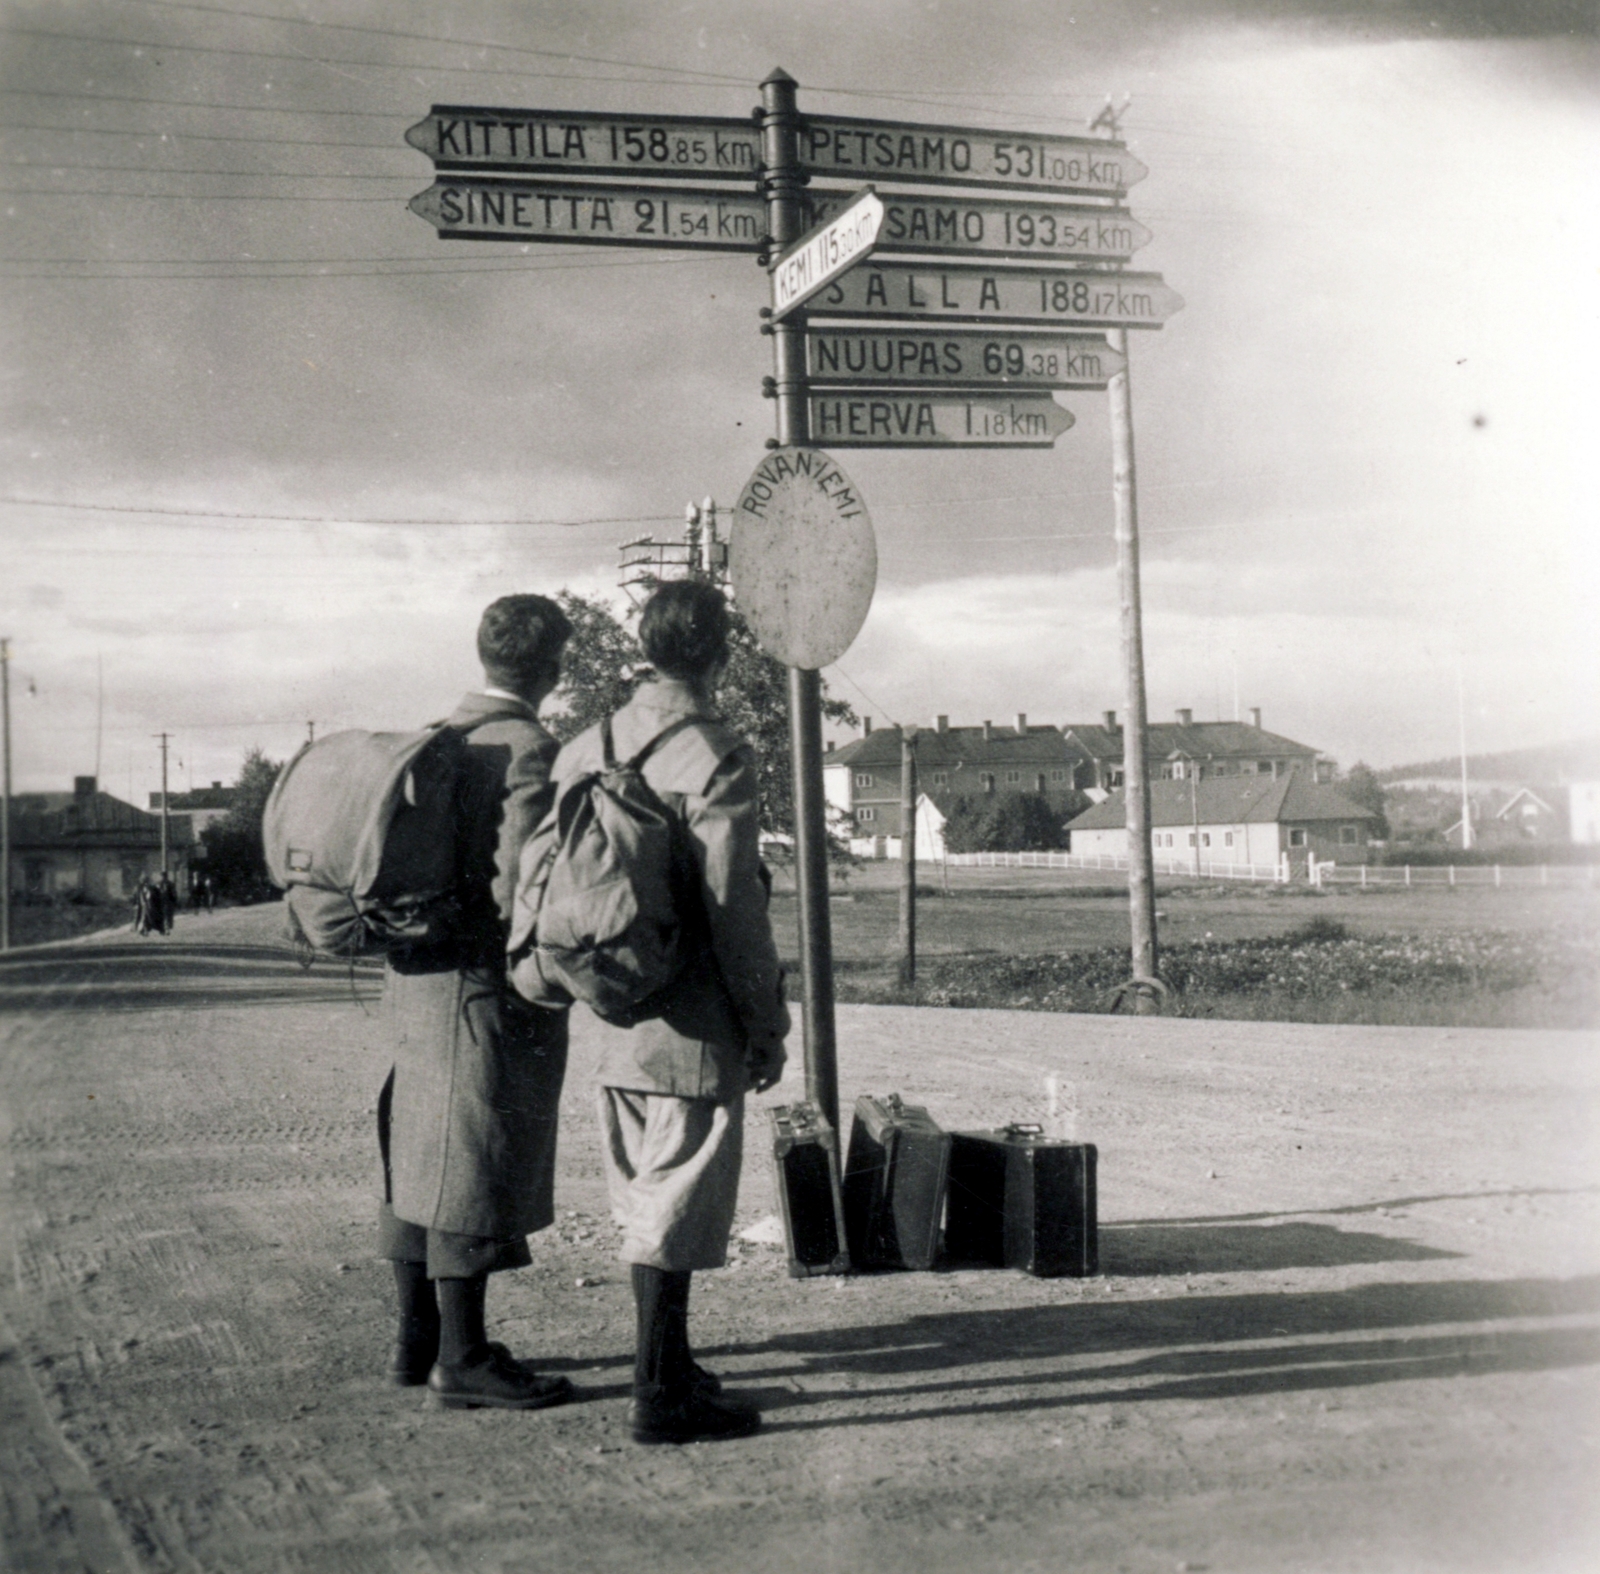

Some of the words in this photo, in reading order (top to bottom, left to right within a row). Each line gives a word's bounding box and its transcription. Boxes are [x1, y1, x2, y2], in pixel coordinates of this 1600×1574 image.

[437, 119, 587, 159] KITTILÄ
[610, 125, 708, 165] 158.85
[714, 131, 754, 165] km
[808, 127, 972, 172] PETSAMO
[994, 143, 1081, 182] 531.00
[440, 187, 614, 232] SINETTÄ
[635, 200, 710, 238] 21.54
[718, 202, 757, 239] km
[808, 202, 985, 243] KSAMO
[1004, 211, 1090, 248] 193.54
[1097, 217, 1132, 249] km
[780, 247, 813, 303] KEMI
[819, 228, 854, 266] 115.30
[855, 211, 874, 250] km
[1040, 279, 1115, 316] 188.17
[817, 338, 962, 375] NUUPAS
[983, 343, 1058, 377] 69.38
[820, 402, 936, 436] HERVA
[965, 401, 1009, 436] 1.18
[742, 452, 862, 519] ROVANIEMI
